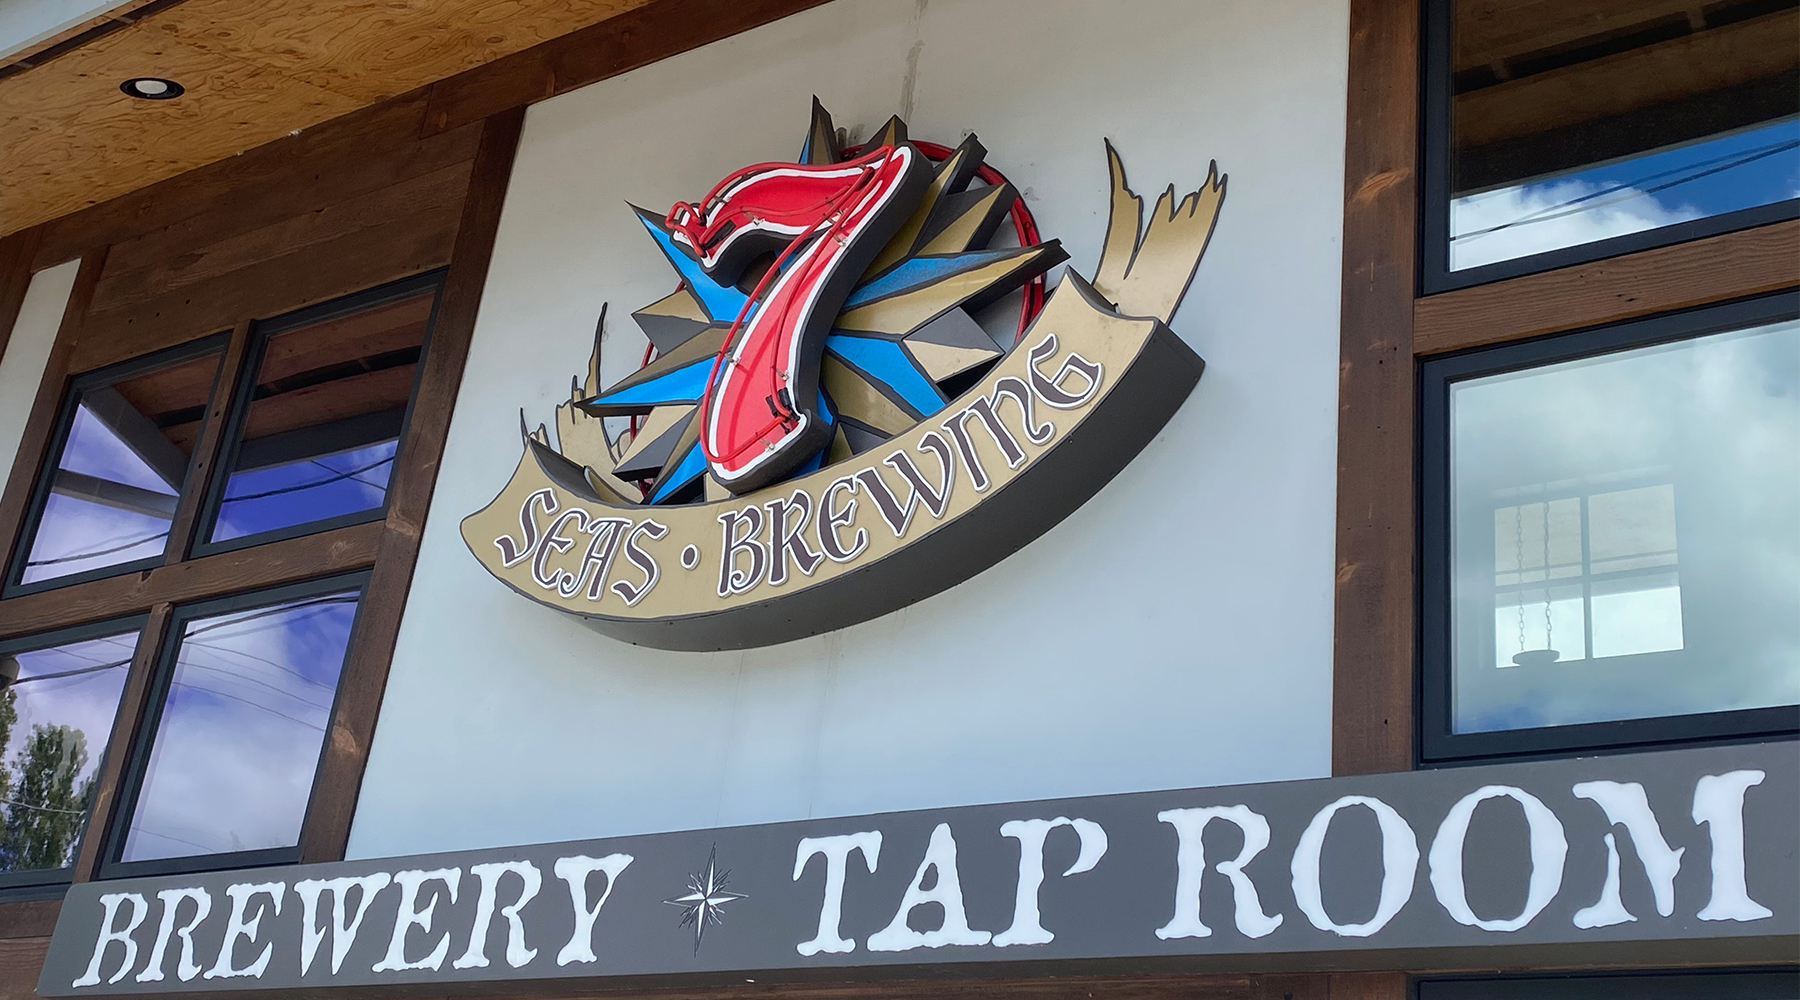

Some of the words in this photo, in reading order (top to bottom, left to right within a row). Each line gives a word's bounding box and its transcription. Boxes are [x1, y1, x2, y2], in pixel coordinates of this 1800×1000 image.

[668, 142, 916, 484] 7
[495, 487, 668, 606] SEAS
[717, 333, 1104, 598] BREWING
[72, 853, 635, 989] BREWERY
[793, 815, 1109, 957] TAP
[1156, 769, 1773, 940] ROOM
